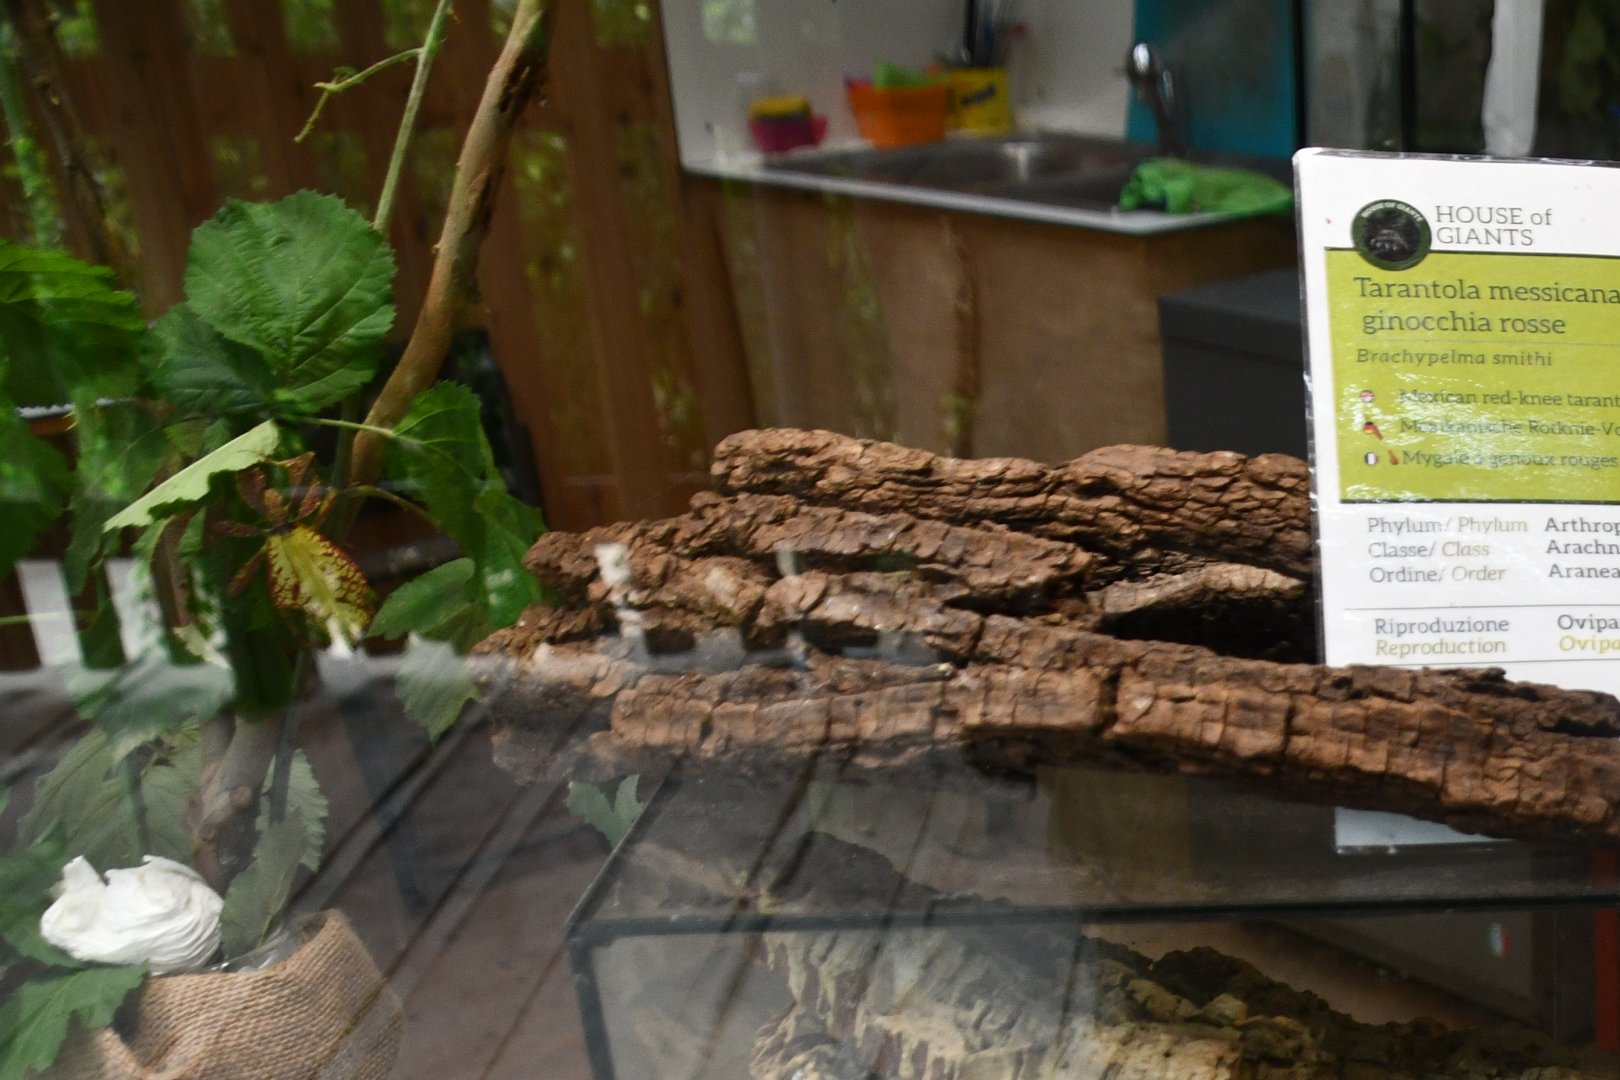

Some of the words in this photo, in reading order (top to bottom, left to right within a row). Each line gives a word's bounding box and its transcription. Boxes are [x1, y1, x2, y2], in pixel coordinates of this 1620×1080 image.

[1435, 204, 1524, 226] HOUSE
[1530, 207, 1554, 226] of
[1436, 226, 1534, 246] GIANTS
[1353, 276, 1481, 300] Tarantola
[1362, 309, 1492, 335] ginocchia
[1500, 316, 1567, 334] rosse
[1356, 348, 1486, 367] Brachypelma
[1491, 351, 1553, 367] smithi
[1399, 388, 1477, 405] Mexican
[1483, 389, 1563, 406] red-knee
[1561, 455, 1618, 470] rouges
[1457, 516, 1529, 535] Phylum
[1368, 541, 1436, 558] Classe/
[1441, 541, 1490, 557] Class
[1451, 565, 1506, 582] Order
[1374, 616, 1510, 637] Riproduzione
[1375, 638, 1507, 658] Reproduction
